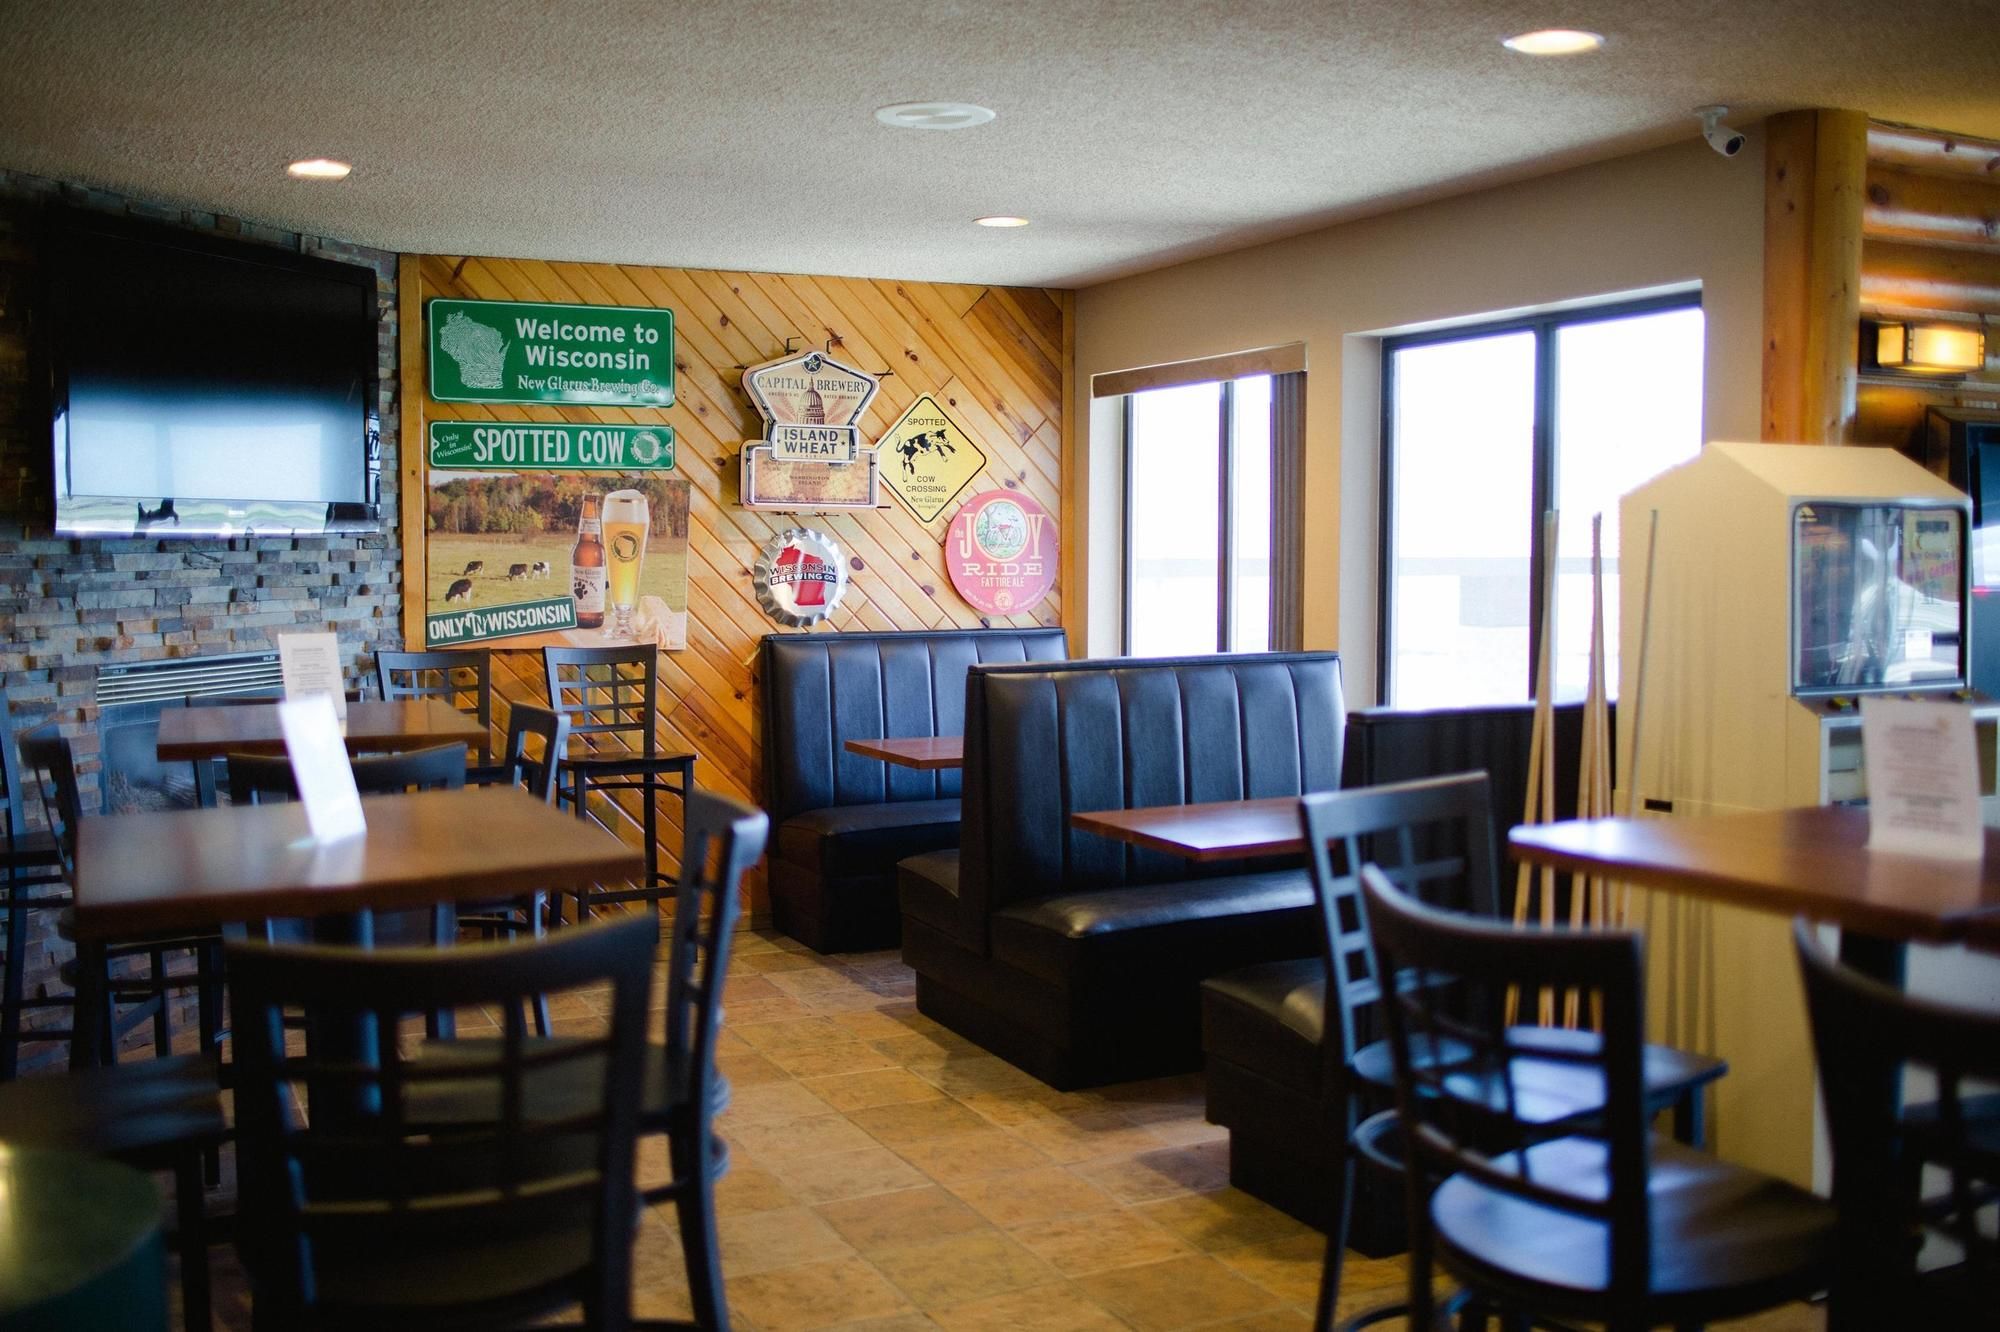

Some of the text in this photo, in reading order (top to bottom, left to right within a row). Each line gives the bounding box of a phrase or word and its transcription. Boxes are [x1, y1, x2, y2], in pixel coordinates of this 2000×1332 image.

[515, 318, 659, 344] Welcome to
[525, 345, 650, 370] Wisconsin
[517, 375, 660, 397] New Glarus Brewing Co.
[758, 376, 867, 393] CAPITAL BREWERY
[907, 418, 946, 426] SPOTTED
[441, 432, 459, 443] Only
[784, 429, 839, 441] ISLAND
[437, 443, 473, 459] Wisconsin!
[472, 428, 570, 463] SPOTTED
[578, 431, 625, 463] COW
[784, 442, 837, 454] WHEAT
[917, 475, 936, 483] COW
[905, 485, 947, 493] CROSSING
[960, 500, 1046, 562] JOY
[770, 563, 836, 575] WISCONSIN
[962, 562, 1043, 576] RIDE
[771, 572, 823, 585] BREWING
[981, 577, 1025, 587] FAT TIRE ALE
[429, 617, 465, 639] ONLY
[486, 604, 572, 632] WISCONSIN
